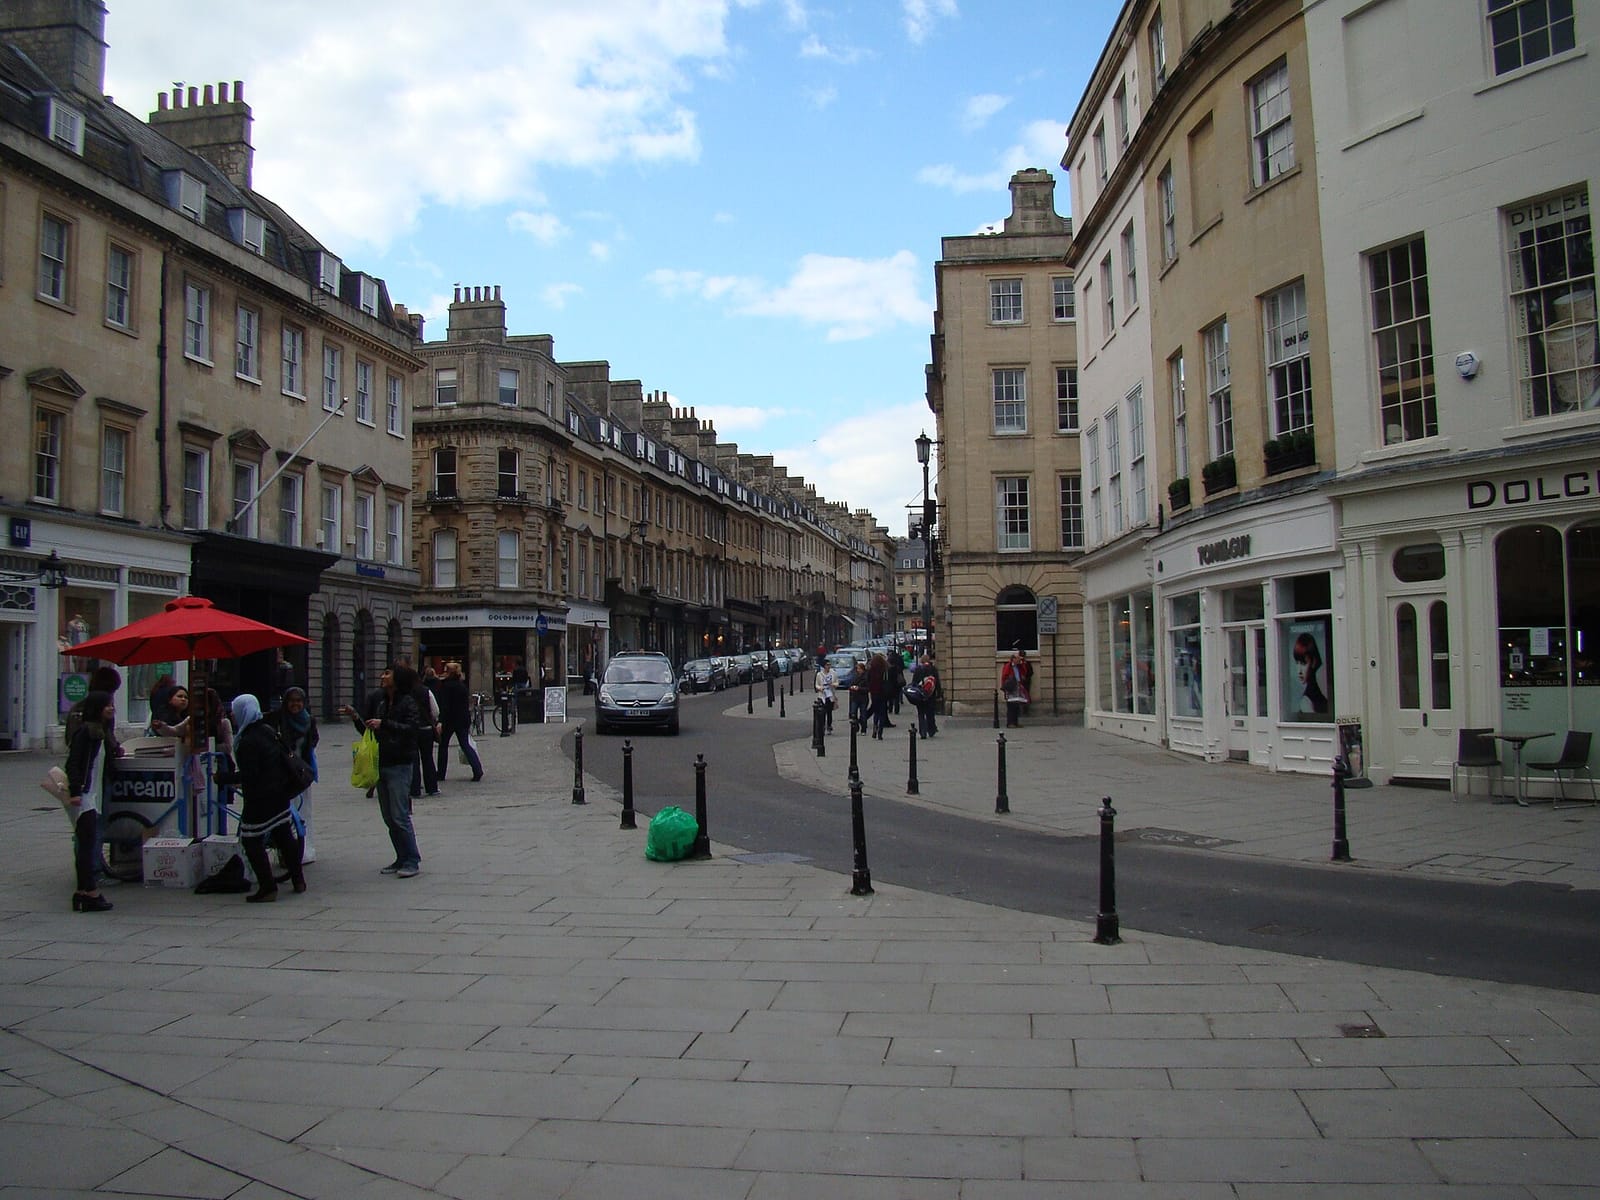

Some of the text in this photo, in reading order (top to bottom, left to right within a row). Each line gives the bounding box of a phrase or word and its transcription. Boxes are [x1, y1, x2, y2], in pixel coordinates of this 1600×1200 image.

[1511, 192, 1589, 226] DOLCE
[1467, 469, 1600, 509] DOLC
[420, 614, 535, 623] GOLDSMITHS GOLDSMITHS
[1336, 716, 1361, 725] DOLCE
[112, 780, 175, 799] cream
